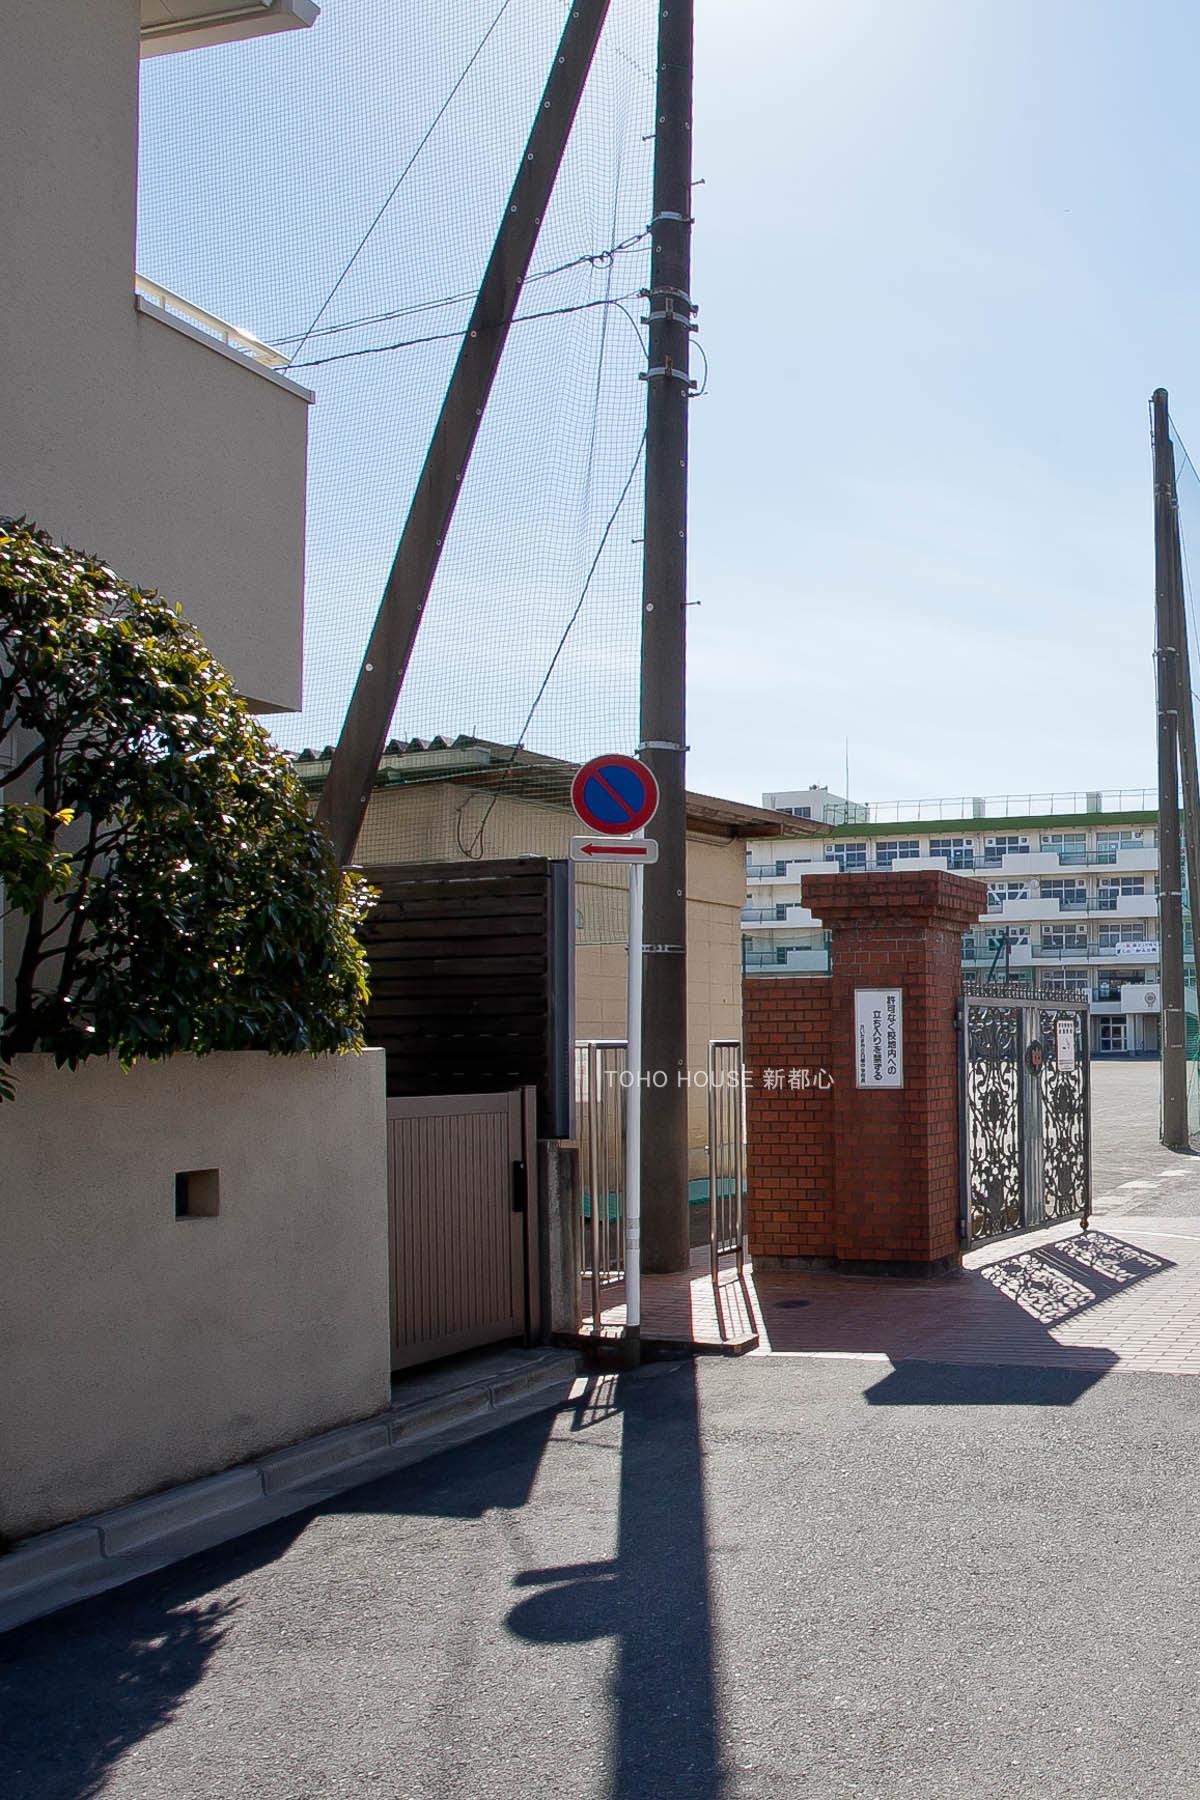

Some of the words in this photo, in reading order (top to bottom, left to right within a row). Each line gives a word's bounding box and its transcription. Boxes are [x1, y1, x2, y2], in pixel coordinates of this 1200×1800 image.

[872, 1010, 883, 1081] 立ち入りを禁ずる
[886, 996, 897, 1075] 許可なく校地内への
